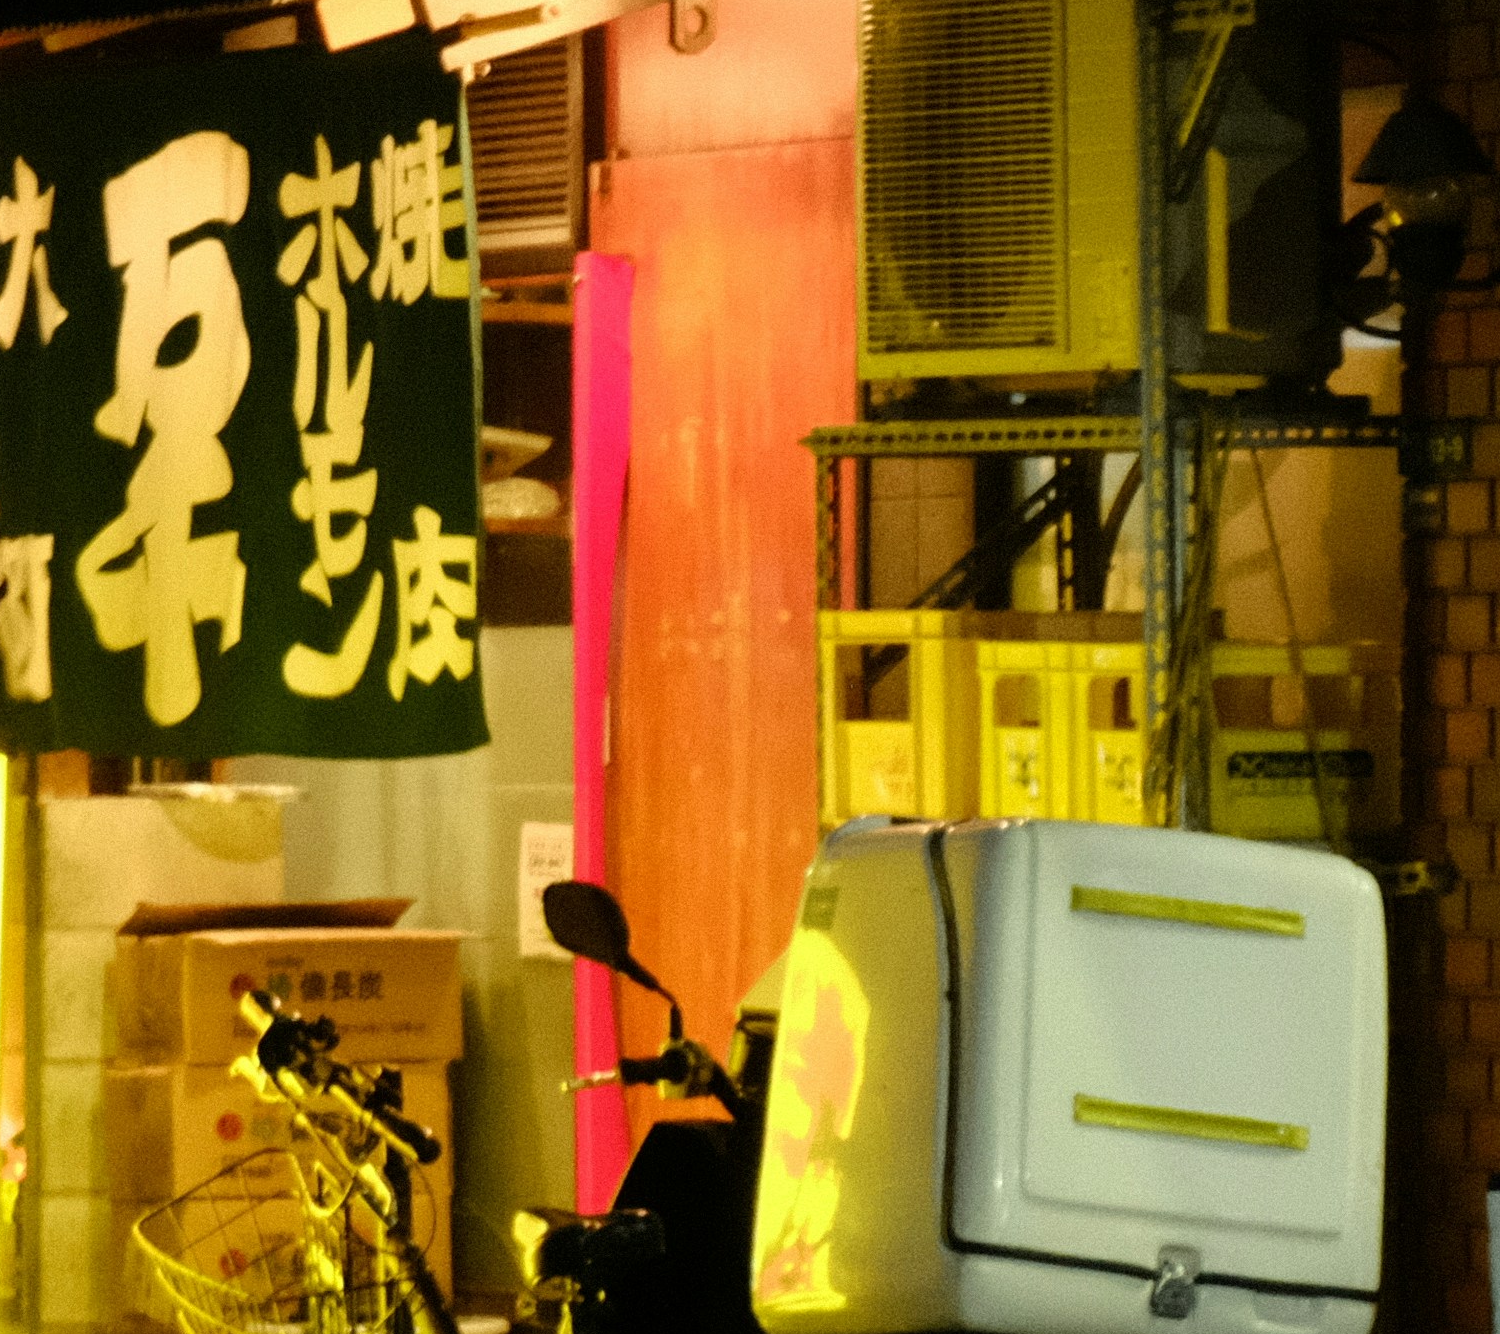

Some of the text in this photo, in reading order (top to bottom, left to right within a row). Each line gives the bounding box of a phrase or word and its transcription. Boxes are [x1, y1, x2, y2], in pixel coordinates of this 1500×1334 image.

[75, 130, 251, 727] 万千
[277, 133, 383, 698] ホルモン
